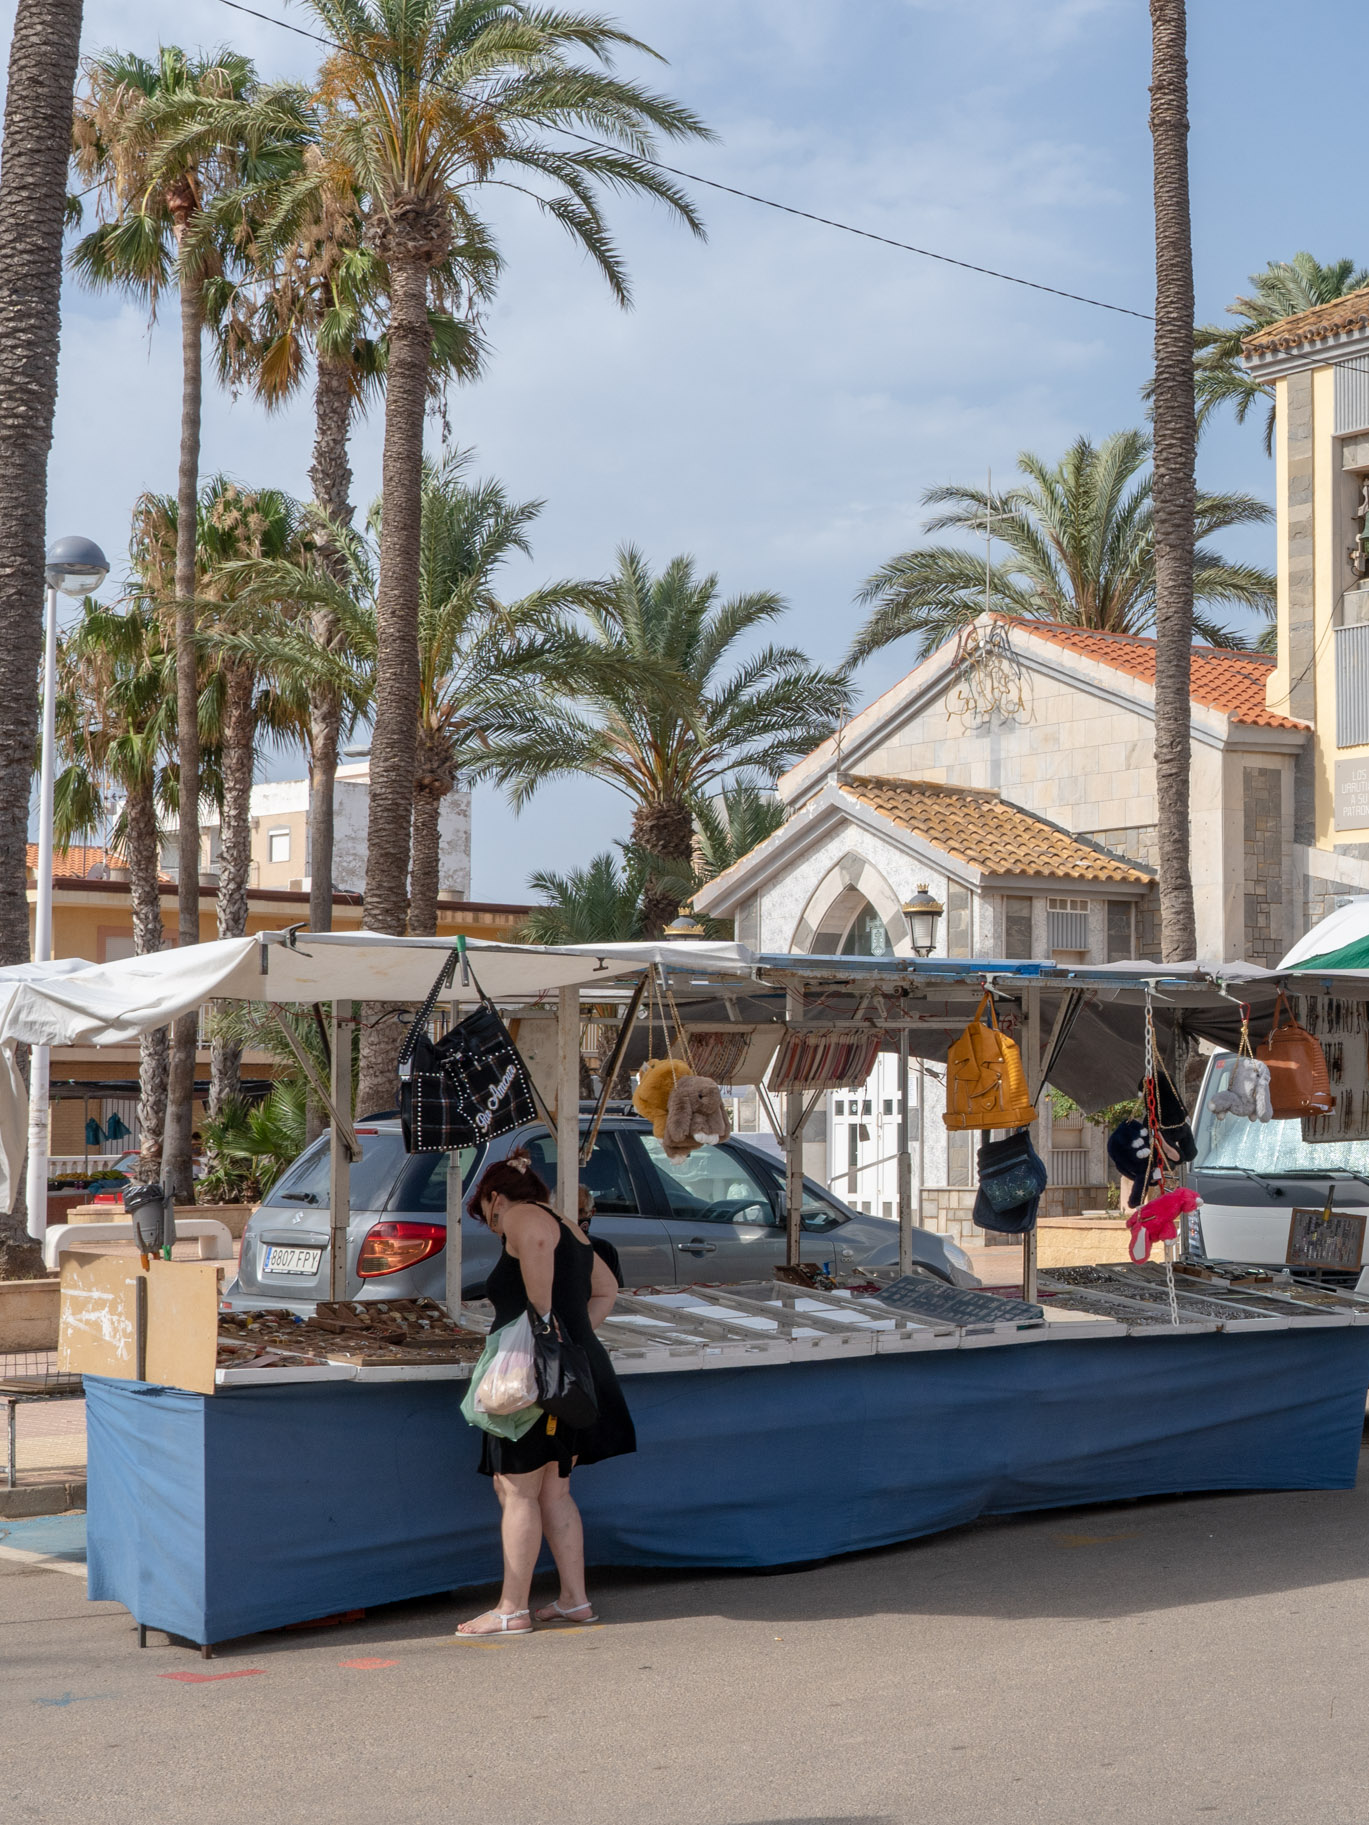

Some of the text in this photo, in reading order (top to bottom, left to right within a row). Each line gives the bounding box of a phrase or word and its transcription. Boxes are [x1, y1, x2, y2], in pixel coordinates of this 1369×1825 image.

[1352, 770, 1367, 781] LOS
[1350, 793, 1368, 805] A SU
[271, 1249, 318, 1268] 8807 FPY
